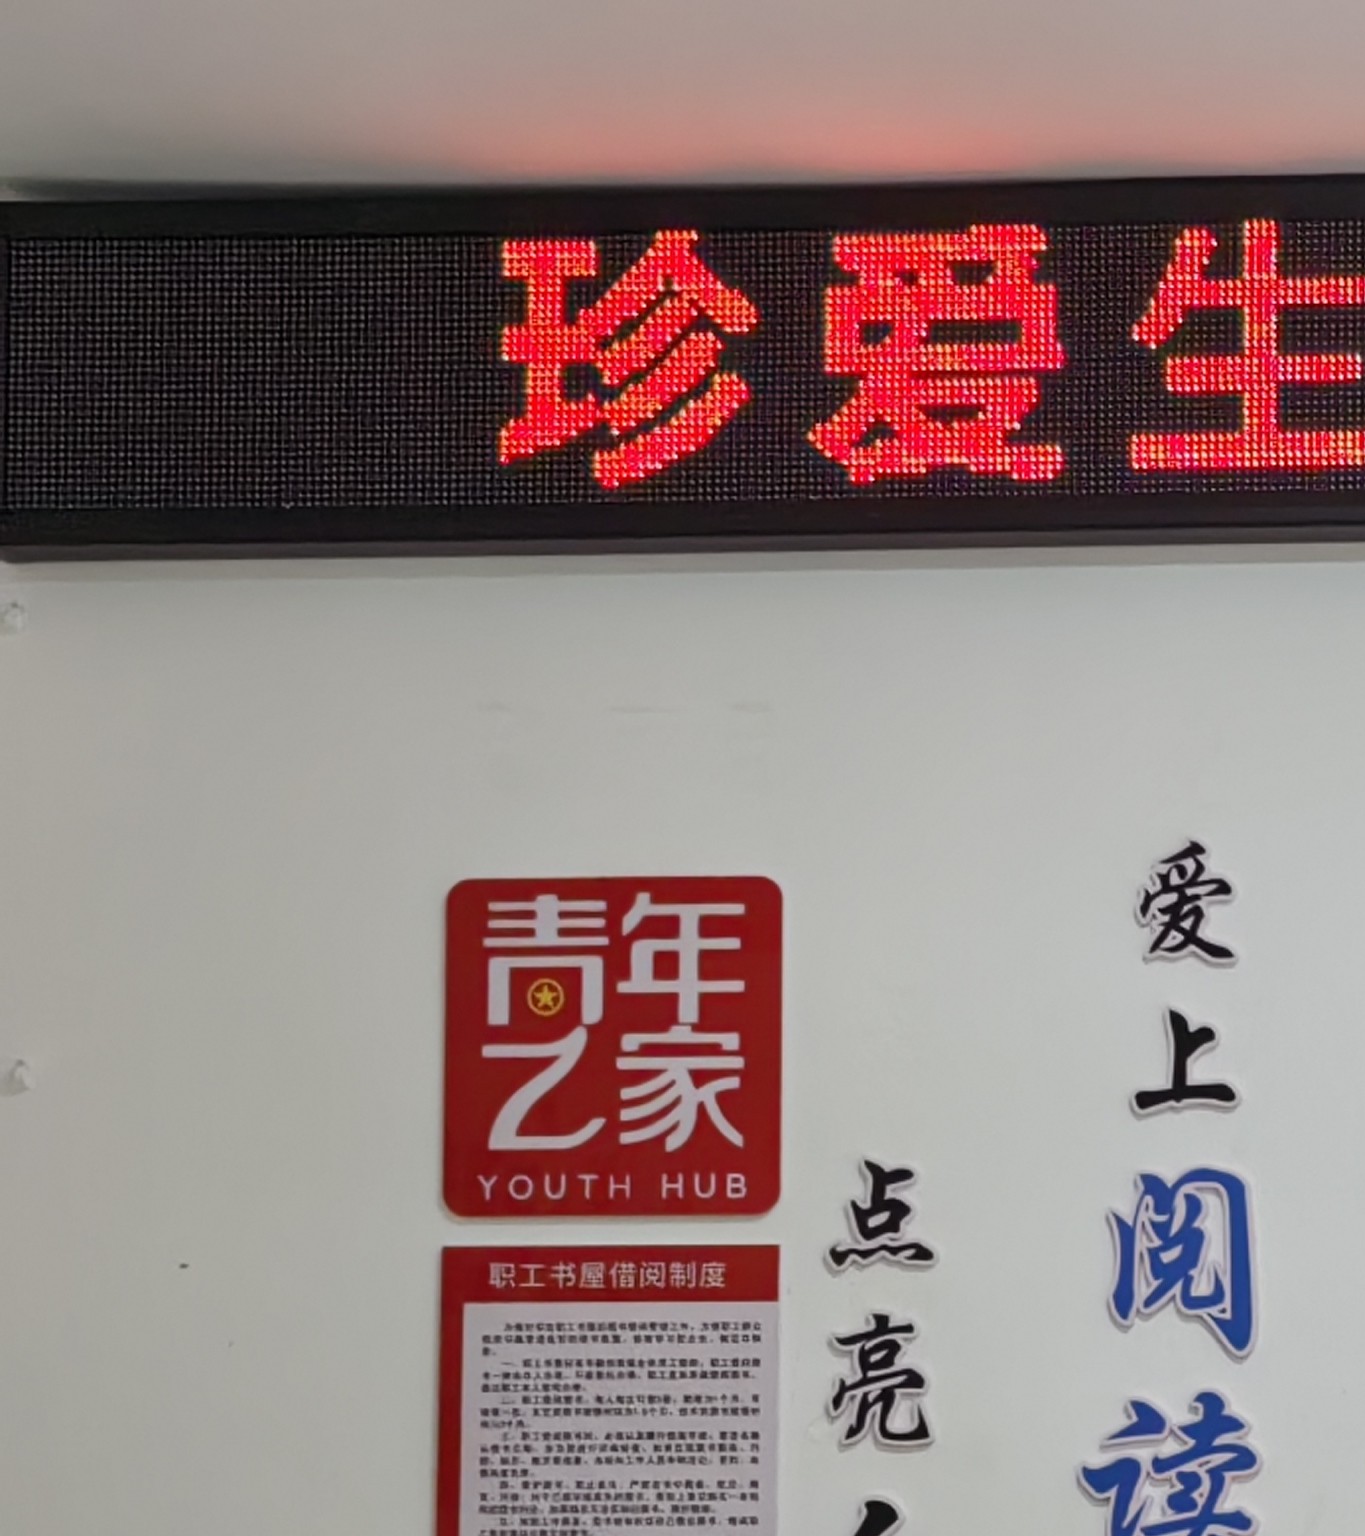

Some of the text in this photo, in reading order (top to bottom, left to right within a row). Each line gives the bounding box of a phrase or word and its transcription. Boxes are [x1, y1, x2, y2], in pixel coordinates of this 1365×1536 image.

[482, 892, 746, 1026] 青年
[477, 1172, 748, 1201] YOUTH HUB
[488, 1261, 728, 1290] 职工书屋借阅制度
